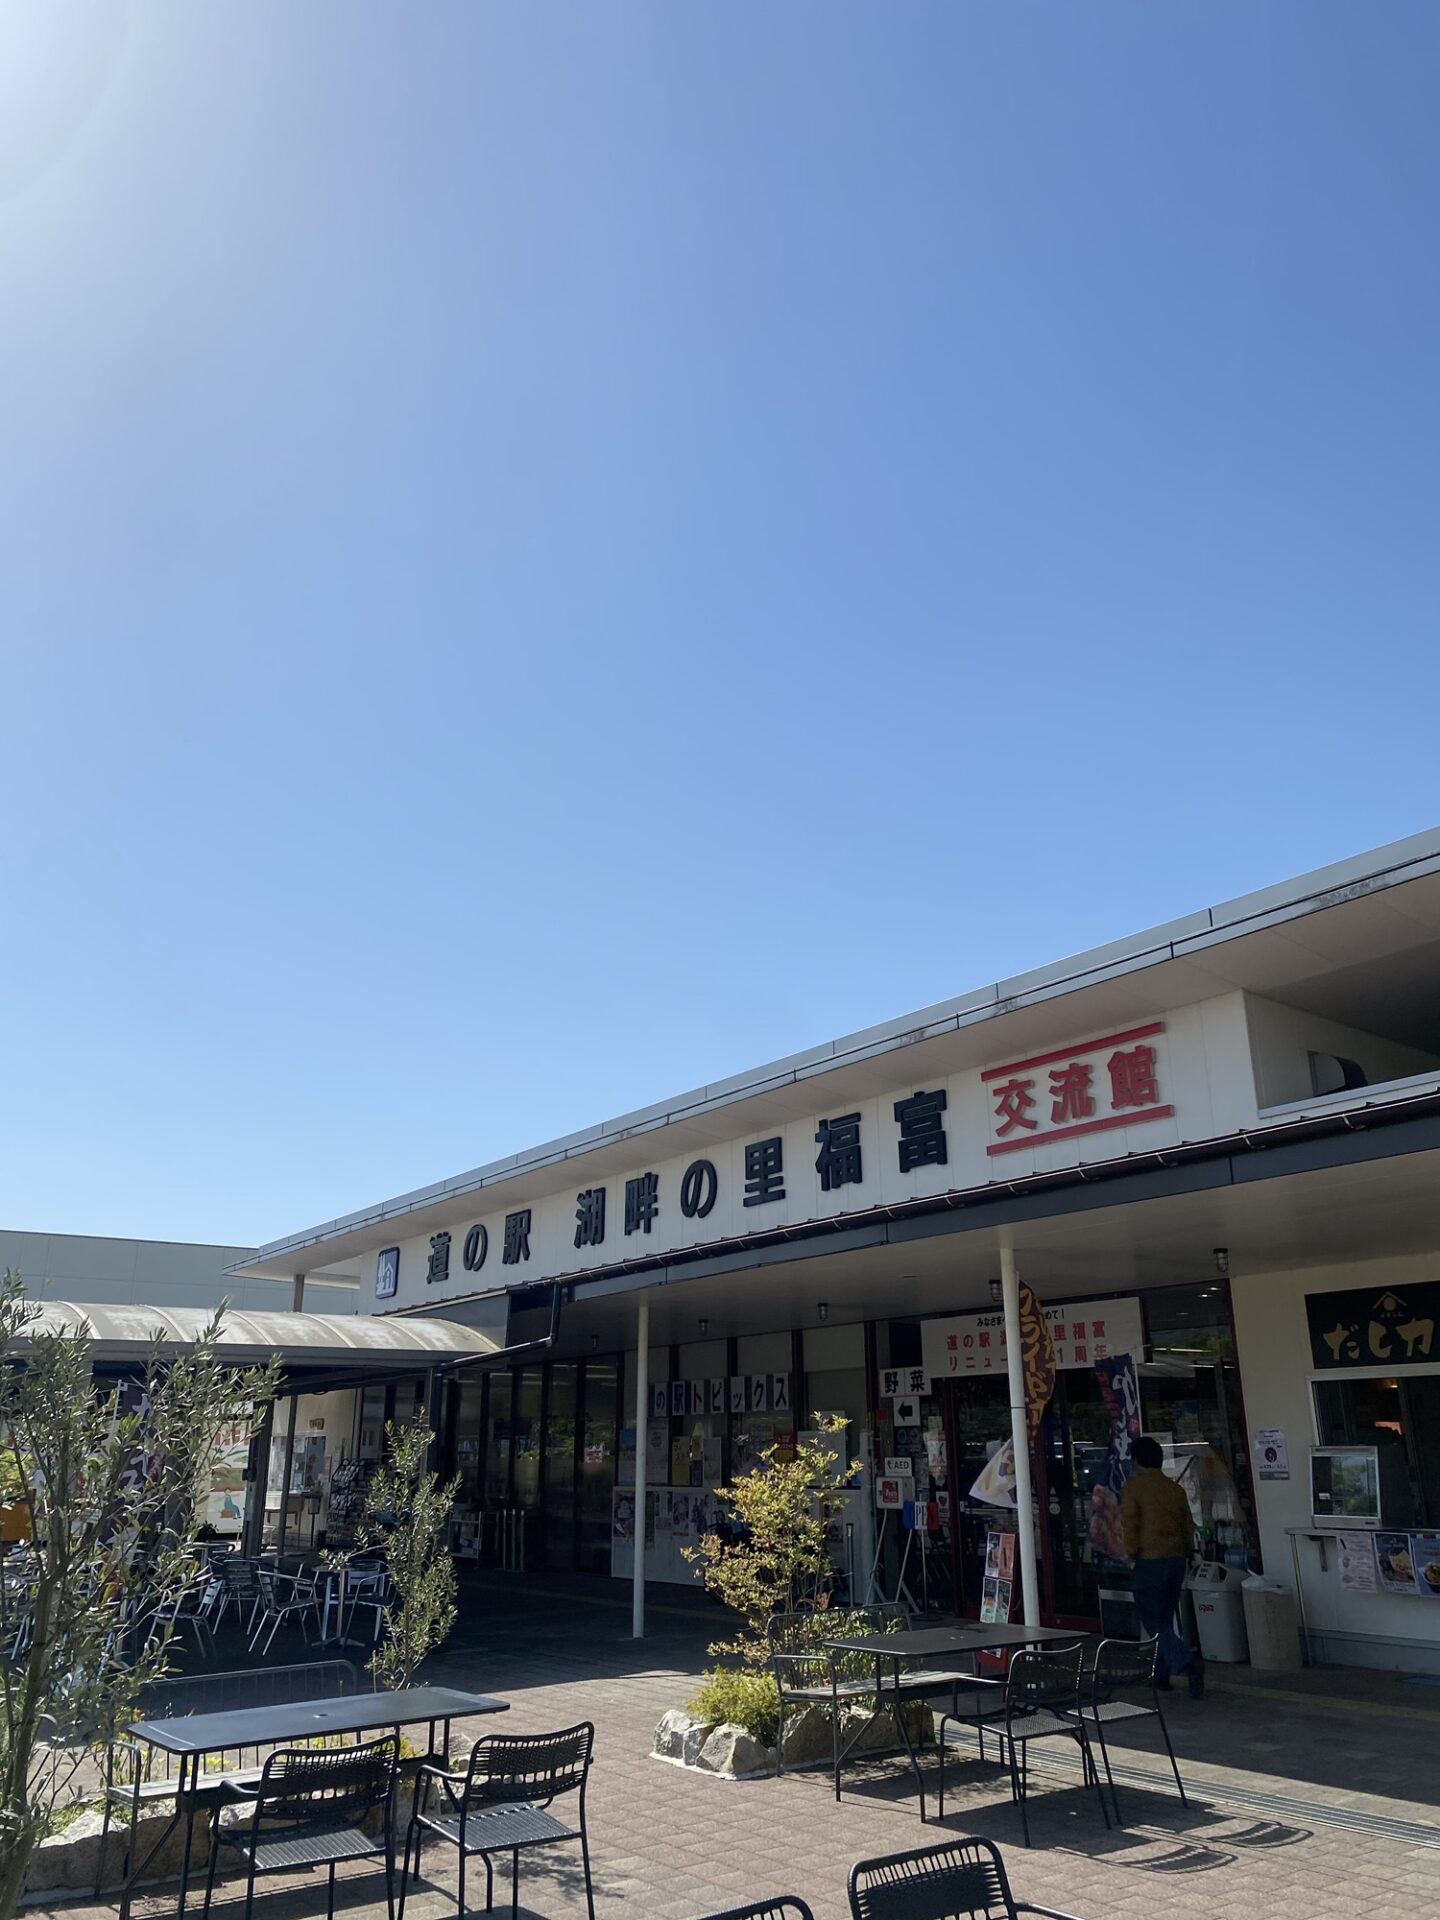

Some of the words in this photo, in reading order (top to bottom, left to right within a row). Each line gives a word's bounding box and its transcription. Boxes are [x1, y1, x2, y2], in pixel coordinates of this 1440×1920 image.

[993, 1046, 1159, 1137] 交流館
[426, 1209, 531, 1284] 道の駅
[573, 1089, 948, 1249] 湖畔の里福富
[885, 1368, 925, 1394] 野菜
[894, 1460, 909, 1470] AED
